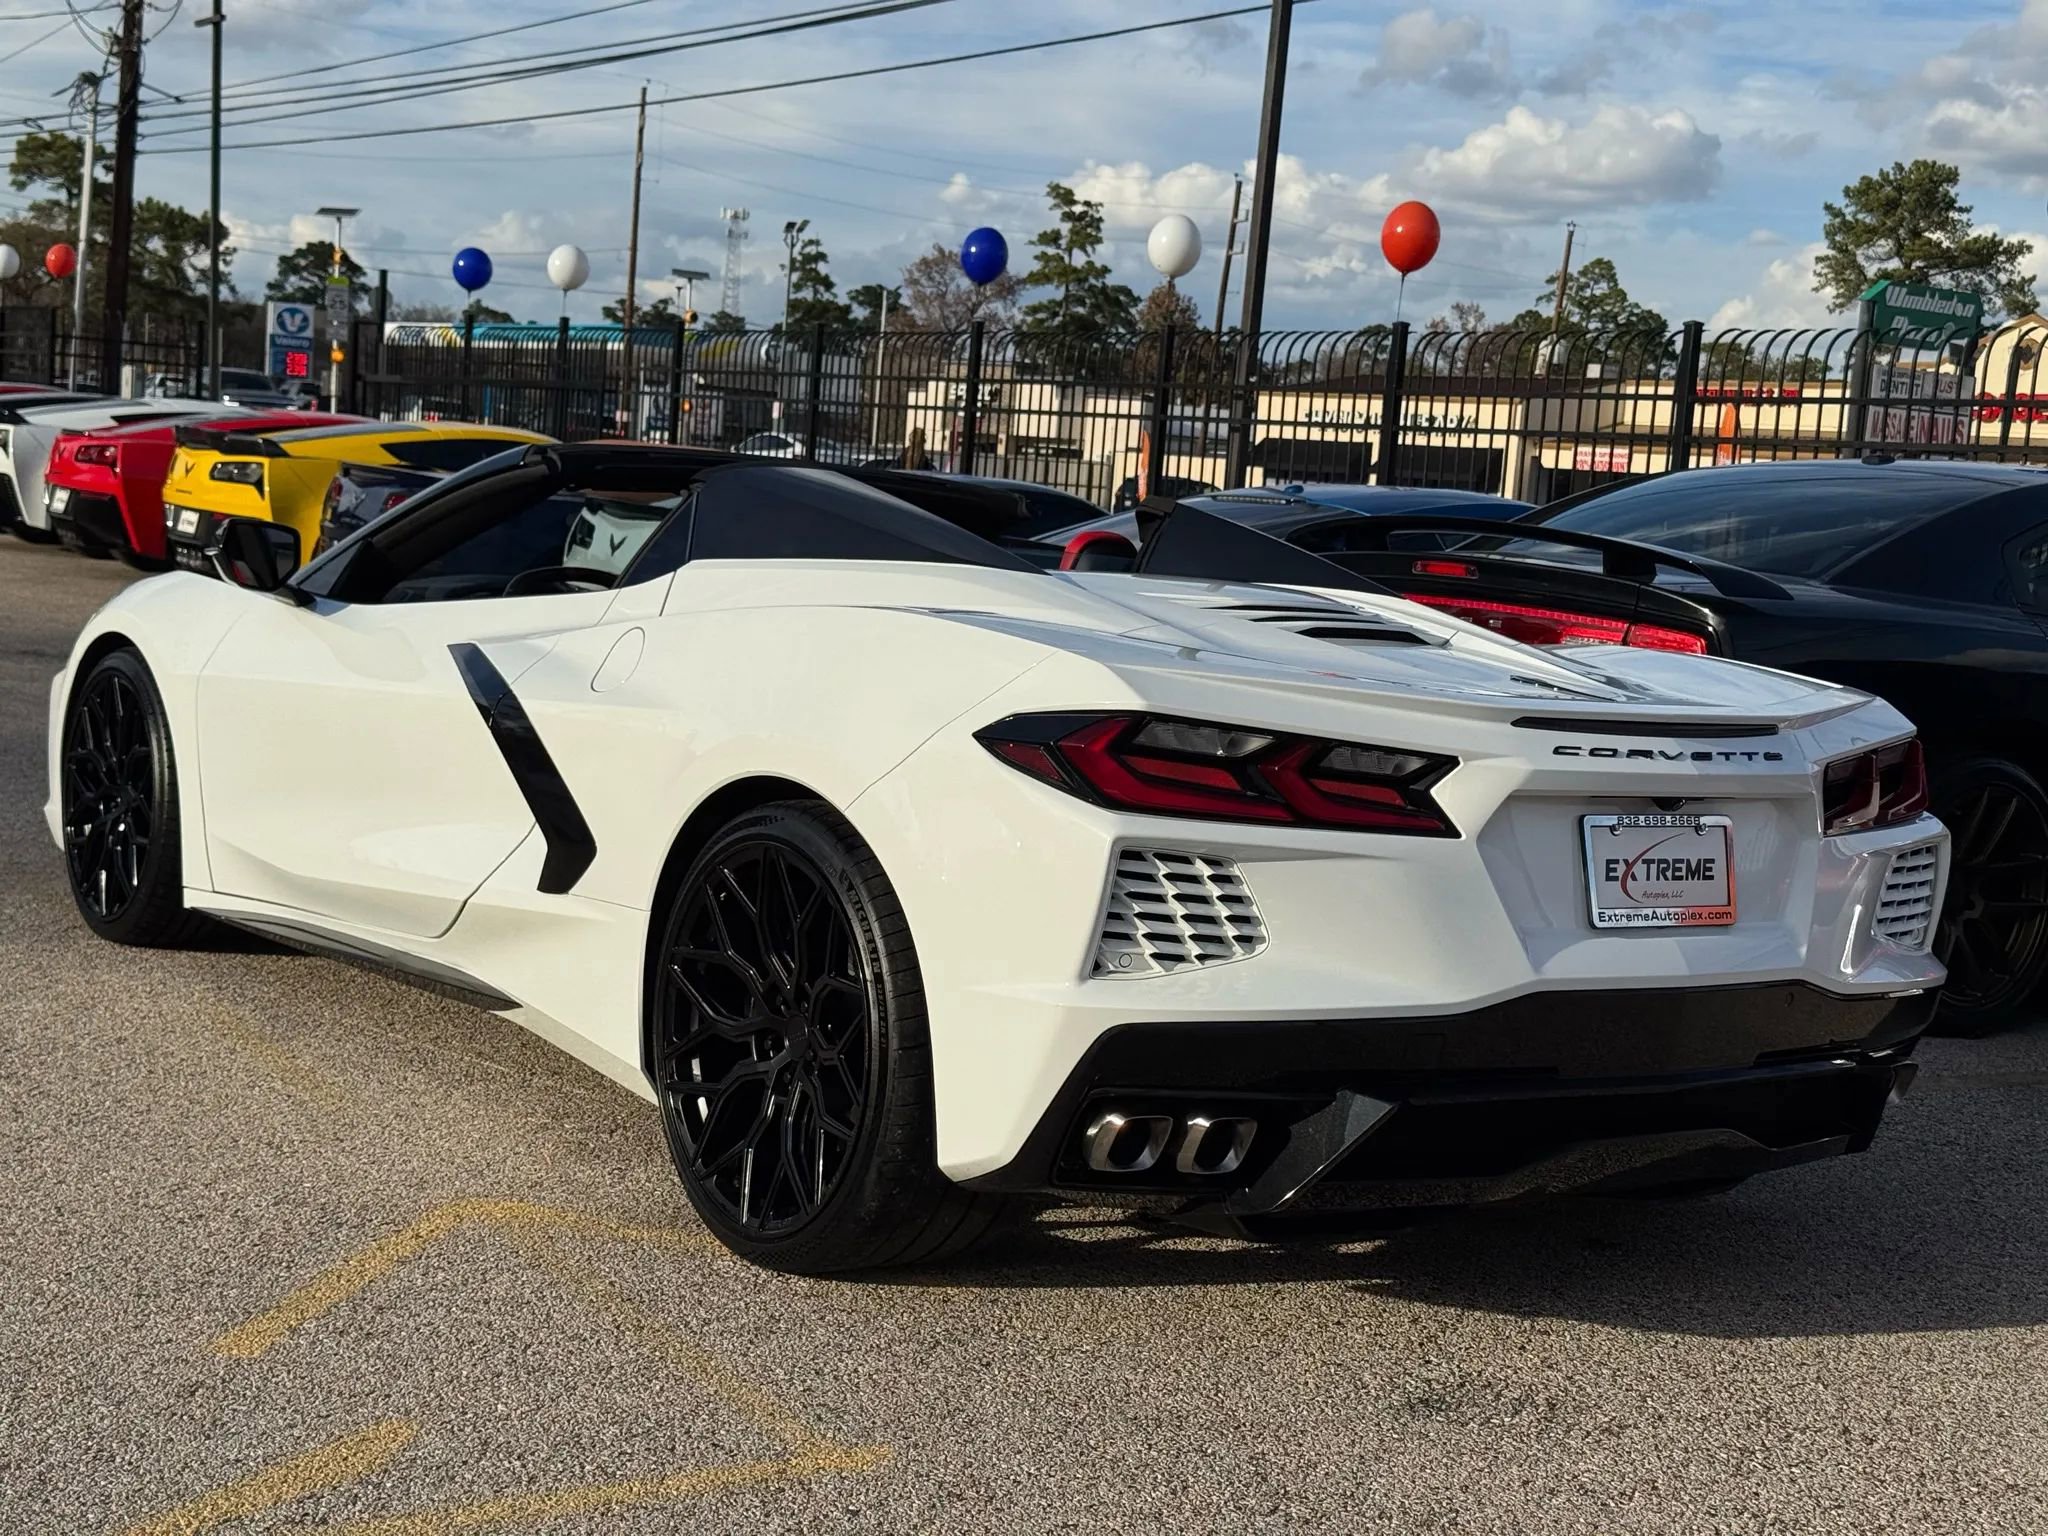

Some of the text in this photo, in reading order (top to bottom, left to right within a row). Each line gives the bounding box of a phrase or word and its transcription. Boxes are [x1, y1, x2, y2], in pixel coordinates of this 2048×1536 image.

[1885, 285, 1976, 318] Wimbledon
[275, 336, 311, 348] Valero
[1552, 745, 1783, 762] CORVETTE
[1605, 858, 1716, 882] EXTREME
[1598, 909, 1733, 924] ExtremeAutoplex.com
[847, 889, 881, 973] MICHELIN
